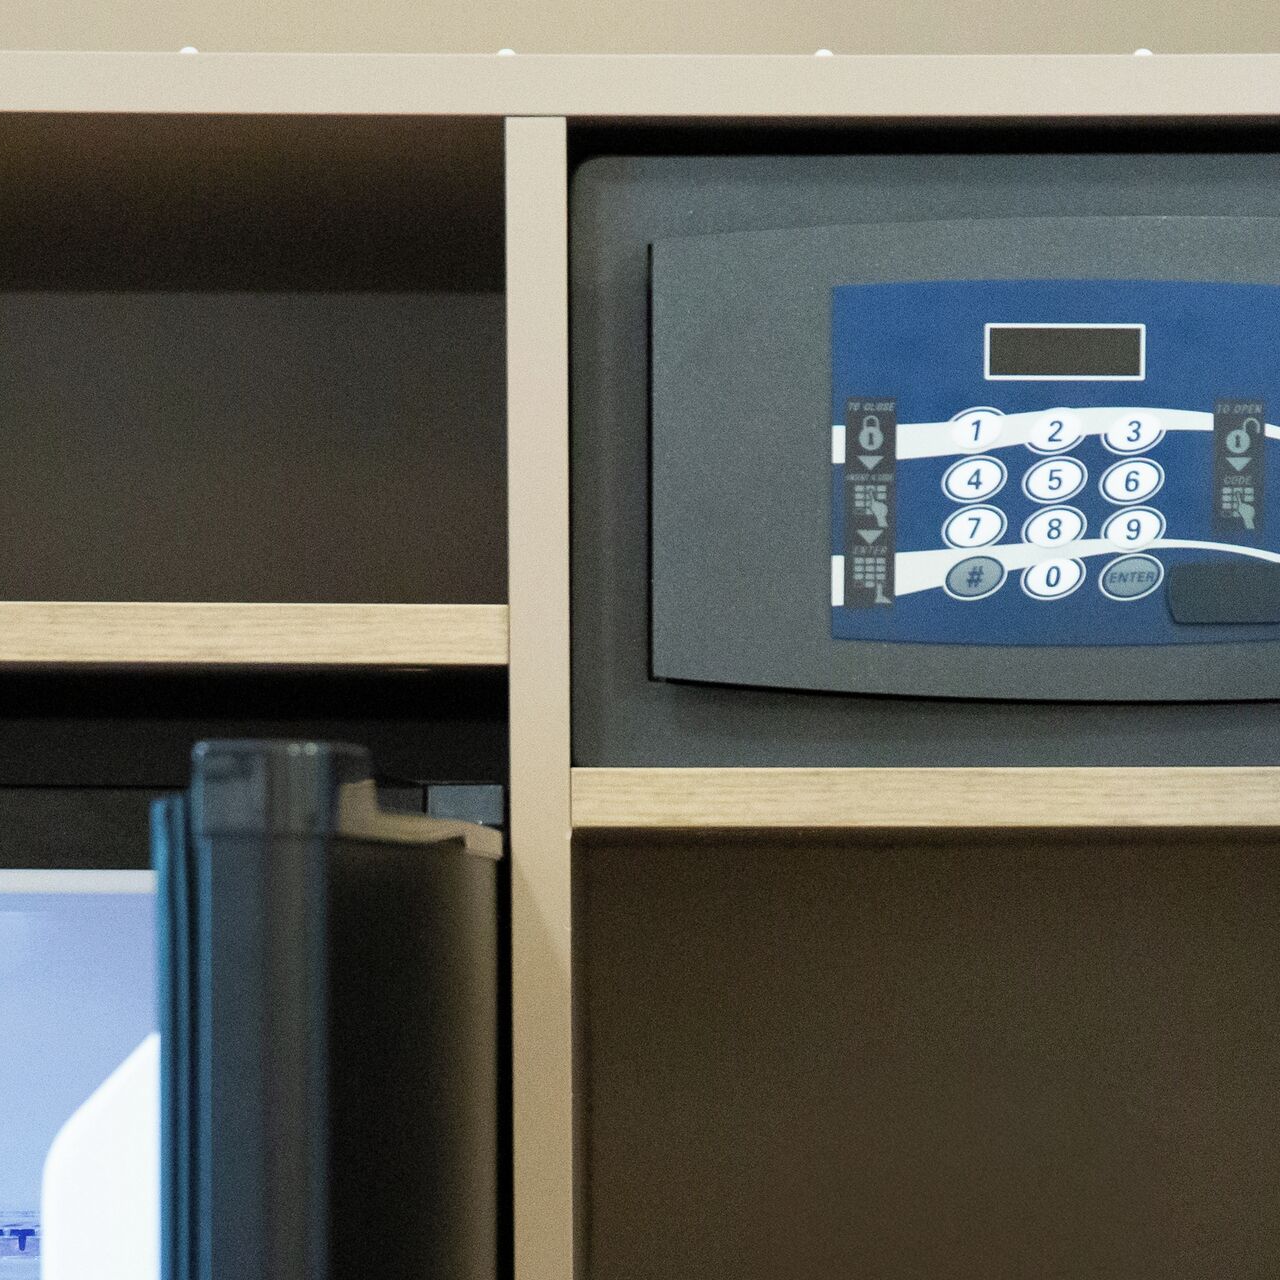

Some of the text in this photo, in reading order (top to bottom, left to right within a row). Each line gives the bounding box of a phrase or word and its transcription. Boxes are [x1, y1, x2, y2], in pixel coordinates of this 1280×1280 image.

[847, 402, 896, 412] TO CLOSE
[1217, 404, 1263, 414] TO OPEN
[971, 419, 1142, 442] 1 2 3
[967, 468, 1140, 492] 4 5 6
[1223, 475, 1252, 485] CODE
[968, 517, 1141, 541] 7 8 9
[853, 545, 888, 555] ENTER
[966, 565, 1156, 588] # 0 ENTER
